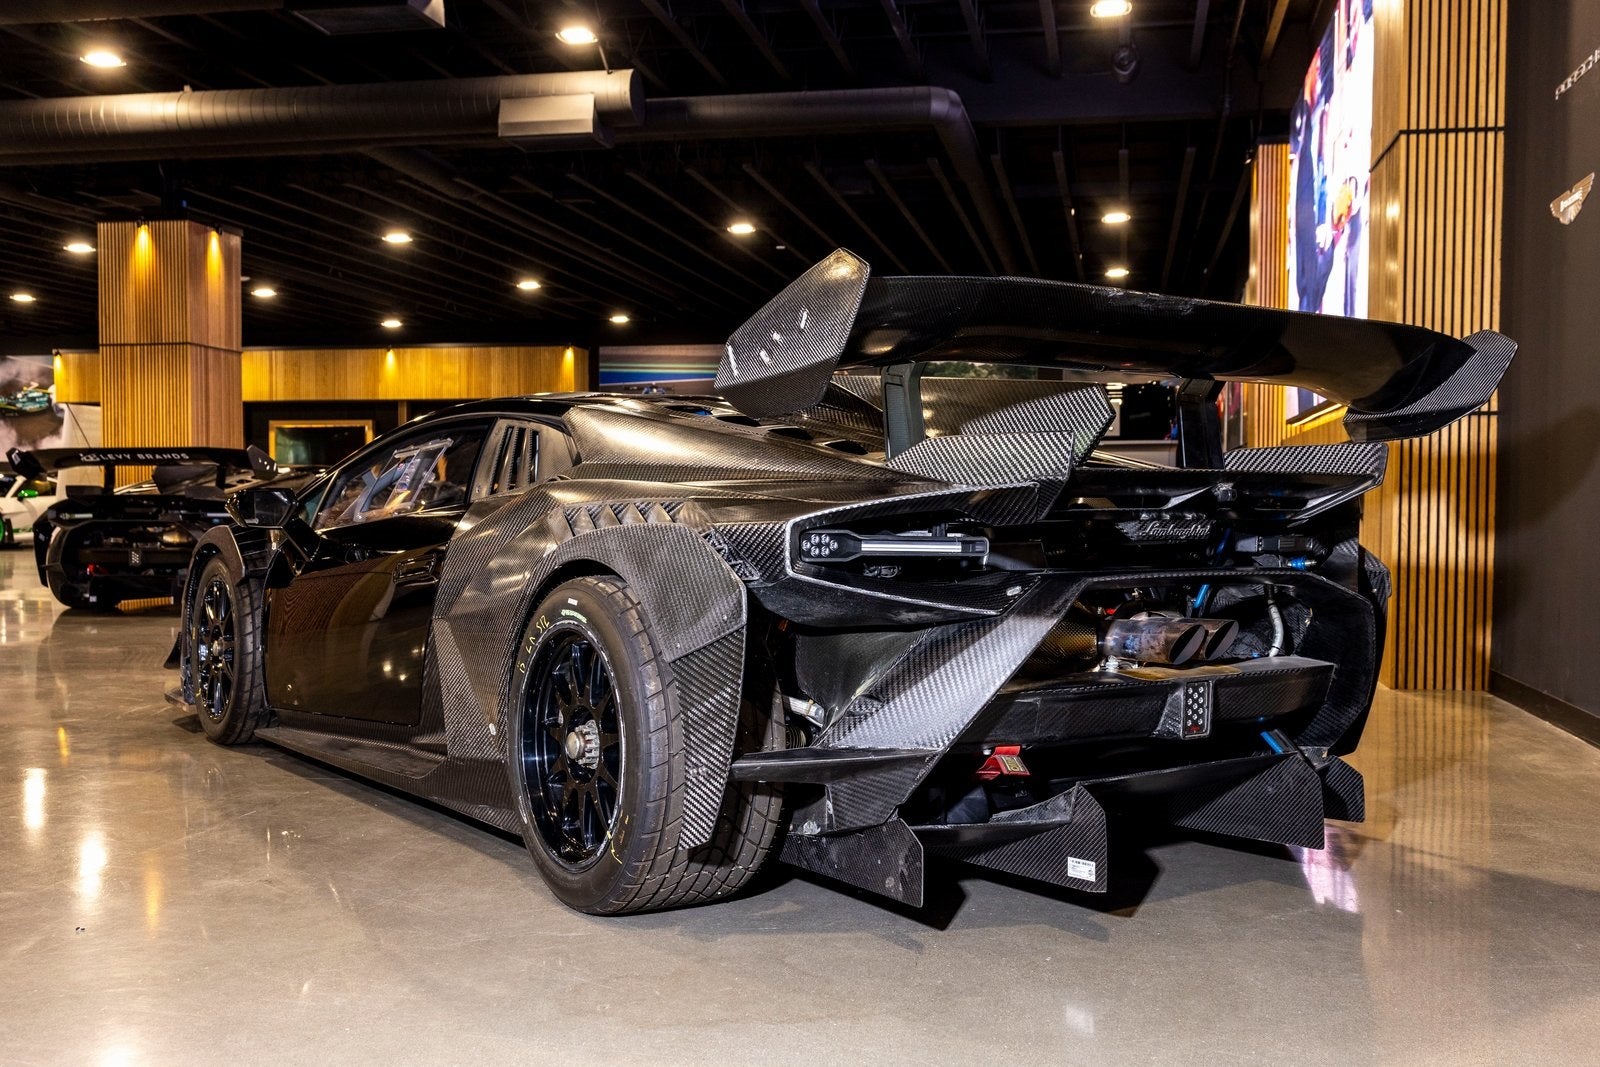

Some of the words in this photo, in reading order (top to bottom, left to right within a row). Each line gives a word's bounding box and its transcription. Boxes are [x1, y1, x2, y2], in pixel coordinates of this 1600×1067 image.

[100, 453, 132, 461] LEVY
[137, 452, 190, 460] BRANDS
[1139, 520, 1211, 539] Lamborghini
